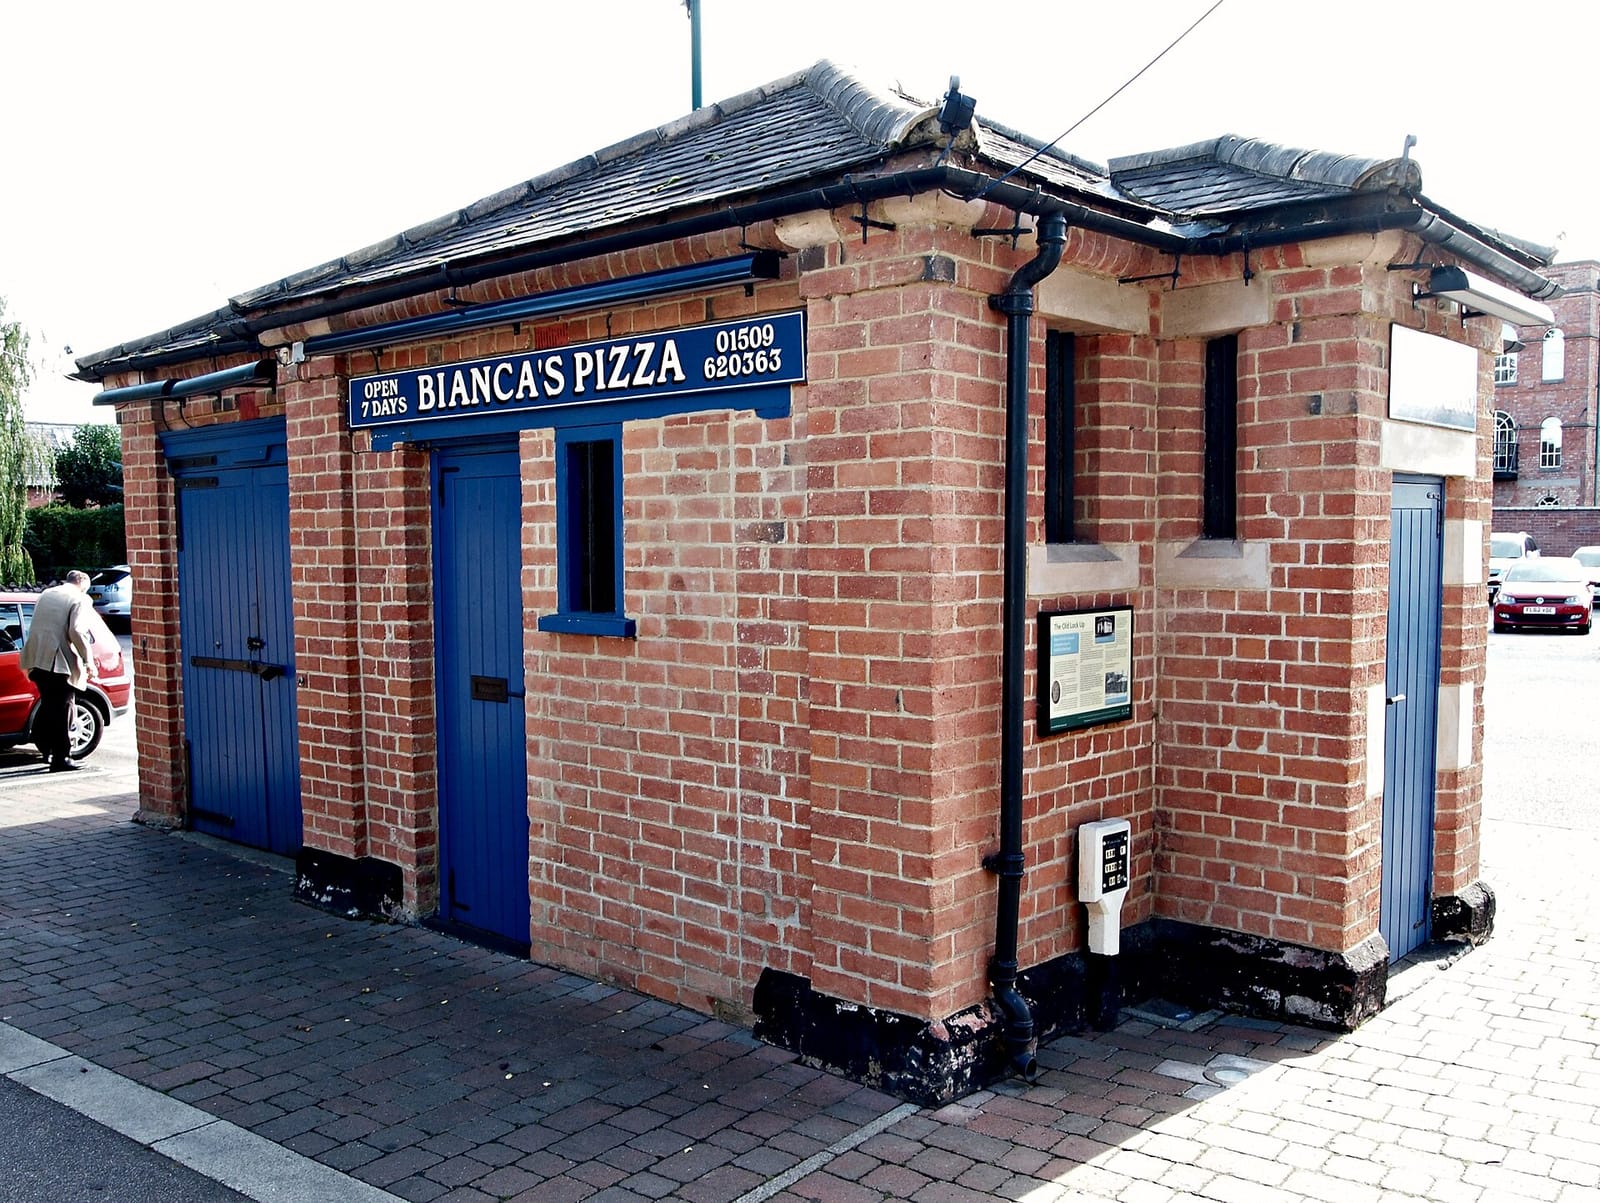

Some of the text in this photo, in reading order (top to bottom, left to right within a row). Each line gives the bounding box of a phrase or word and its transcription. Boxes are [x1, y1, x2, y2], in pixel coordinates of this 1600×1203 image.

[716, 323, 774, 352] 01509
[417, 339, 686, 411] BIANCA'S PIZZA
[704, 348, 782, 379] 620363
[364, 379, 399, 399] OPEN
[361, 396, 408, 418] 7 DAYS
[1053, 622, 1061, 630] The
[1061, 621, 1069, 630] Old
[1070, 621, 1079, 629] Lock
